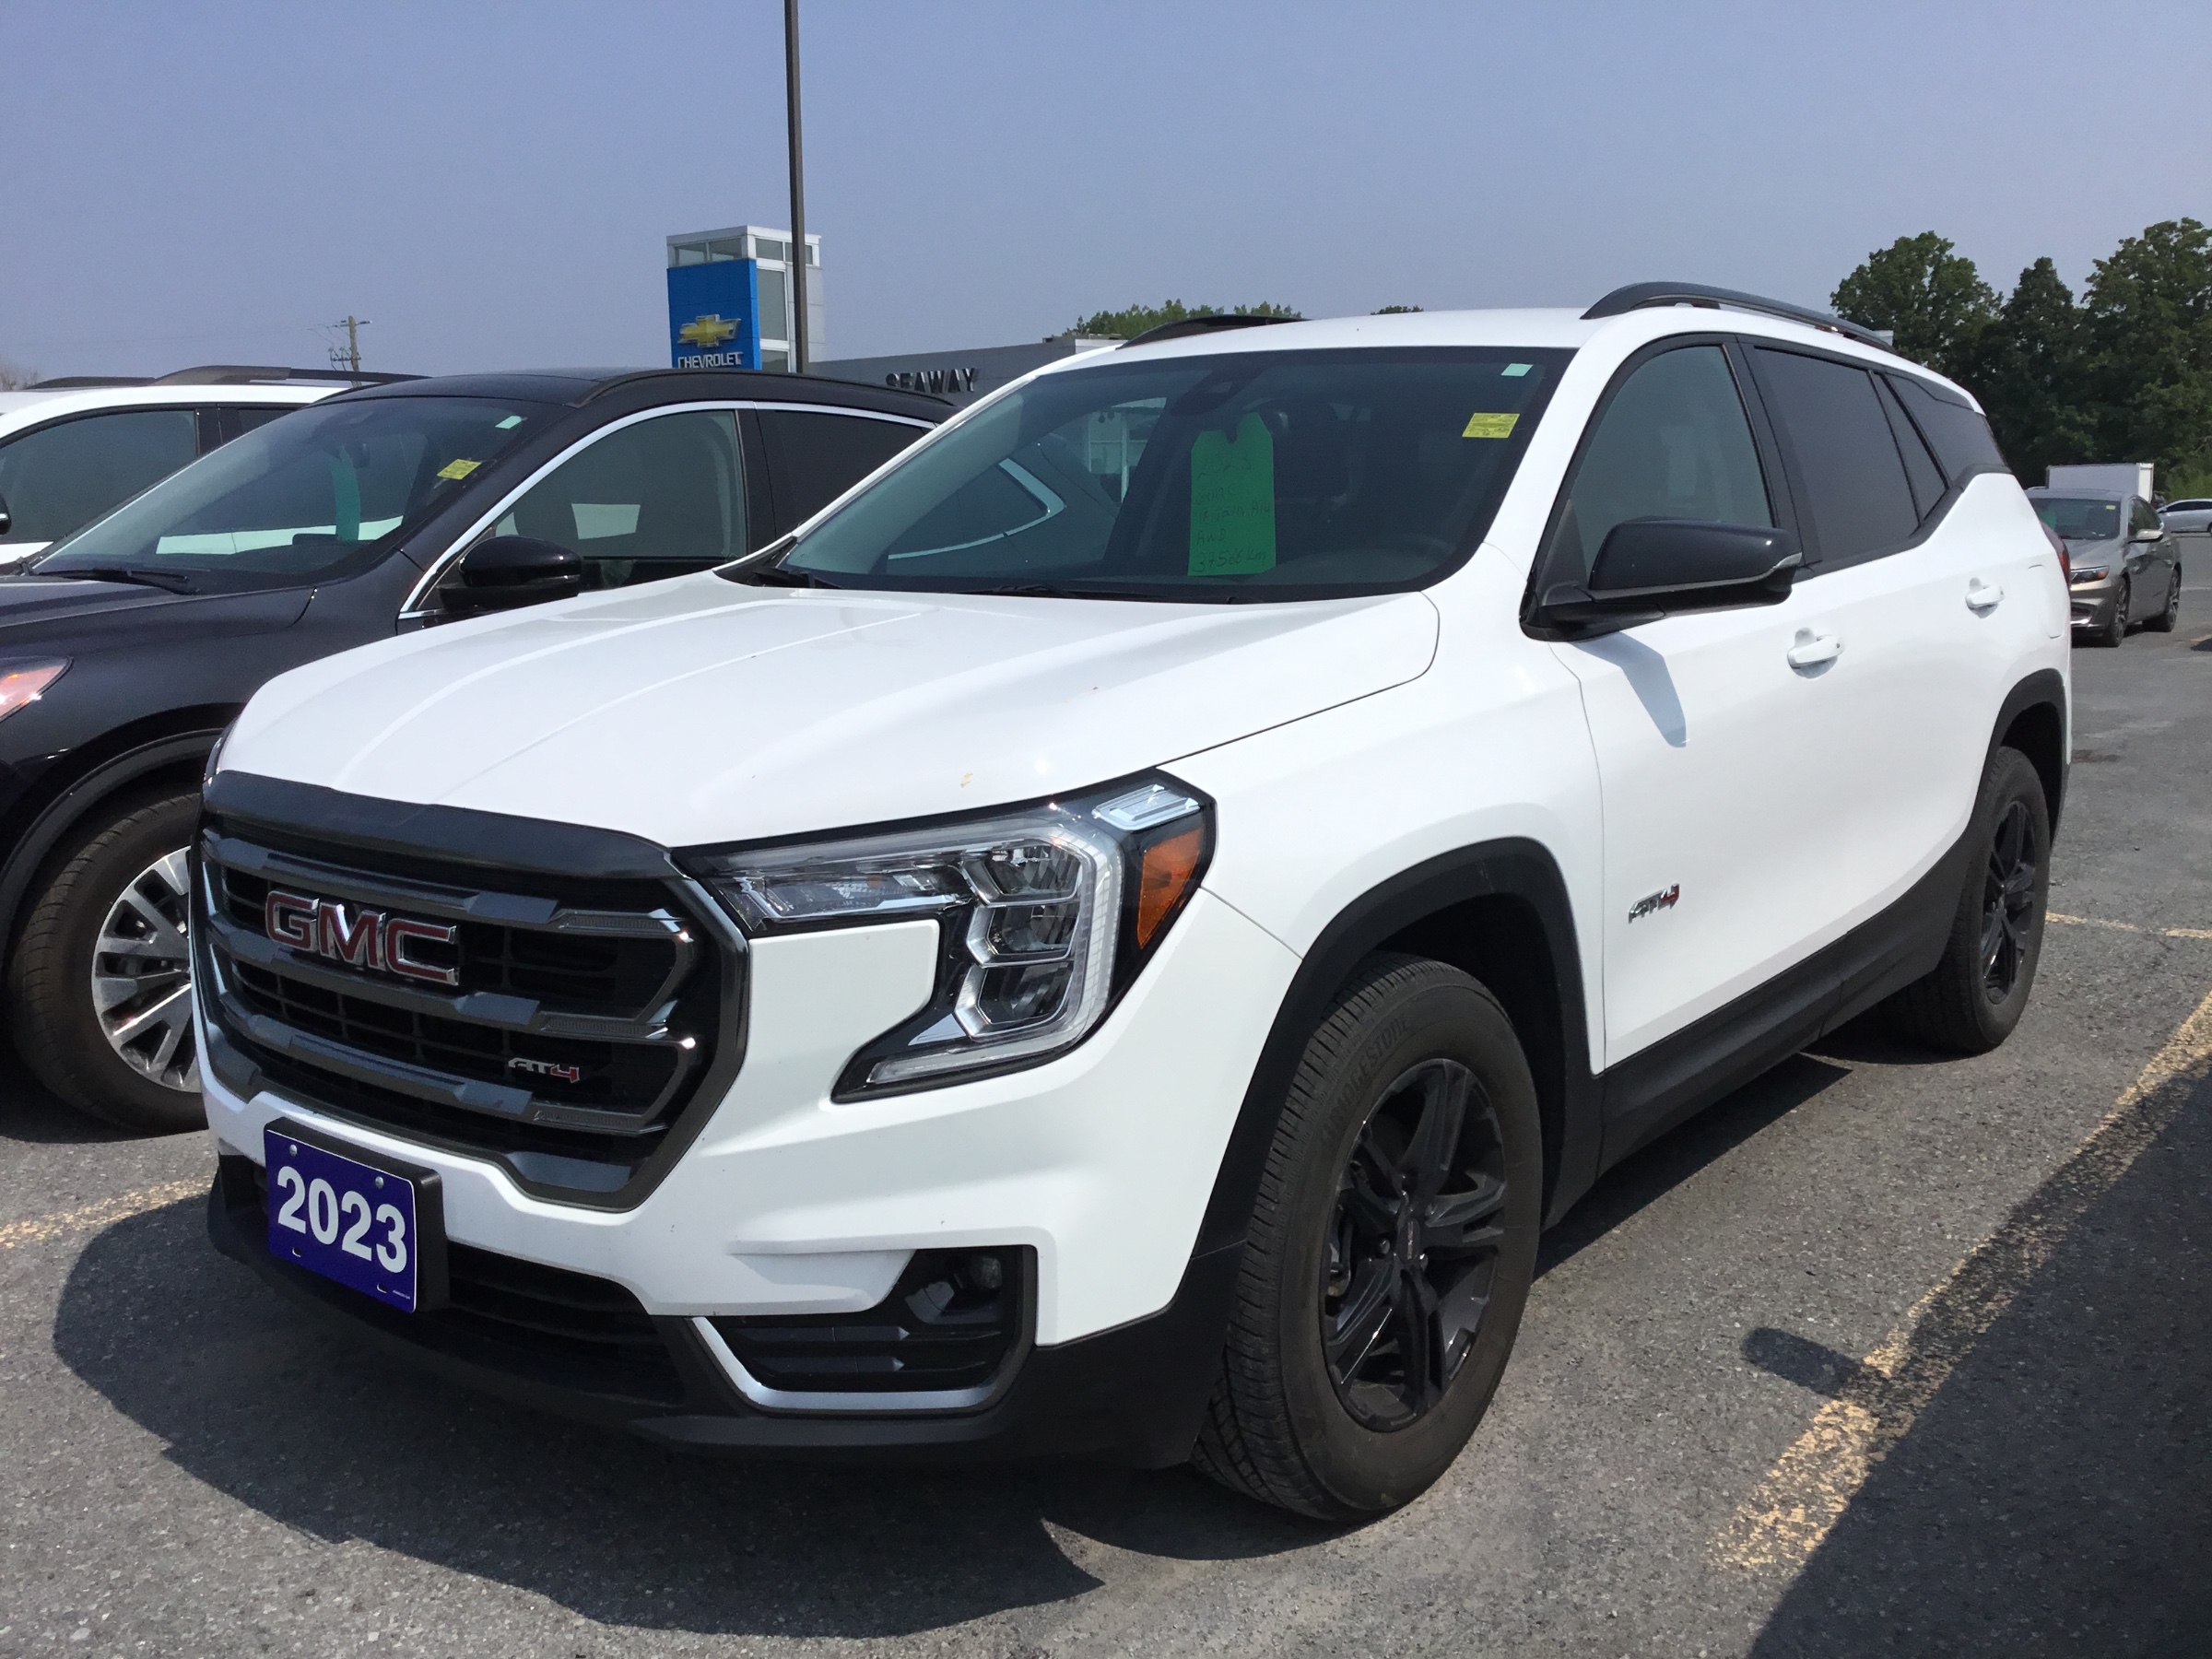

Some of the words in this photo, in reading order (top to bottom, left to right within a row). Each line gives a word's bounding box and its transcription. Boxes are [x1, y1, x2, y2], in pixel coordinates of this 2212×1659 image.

[677, 351, 743, 369] CHEVROLET
[886, 367, 977, 394] SEAWAY
[265, 890, 460, 987] GMC
[508, 1057, 581, 1084] AT4
[276, 1165, 408, 1274] 2023
